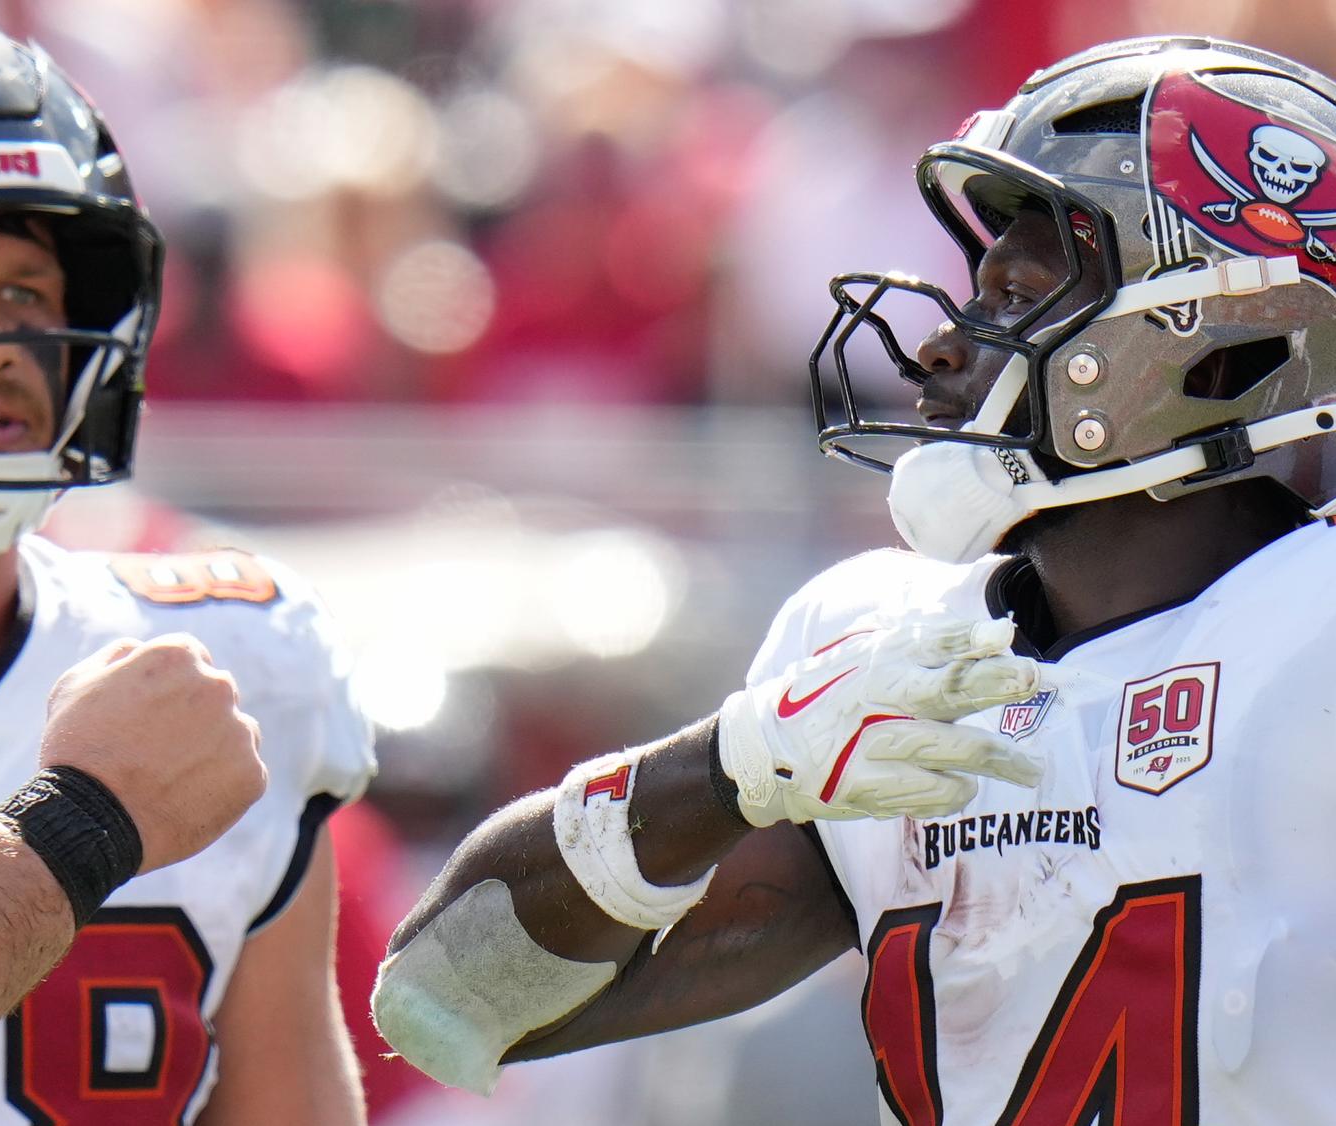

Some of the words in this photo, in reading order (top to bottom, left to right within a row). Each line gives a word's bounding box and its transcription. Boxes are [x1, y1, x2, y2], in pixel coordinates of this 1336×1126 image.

[1002, 705, 1034, 731] NFL
[1127, 677, 1205, 746] 50
[1136, 736, 1187, 757] SEASONS
[923, 806, 1102, 870] BUCCANEERS
